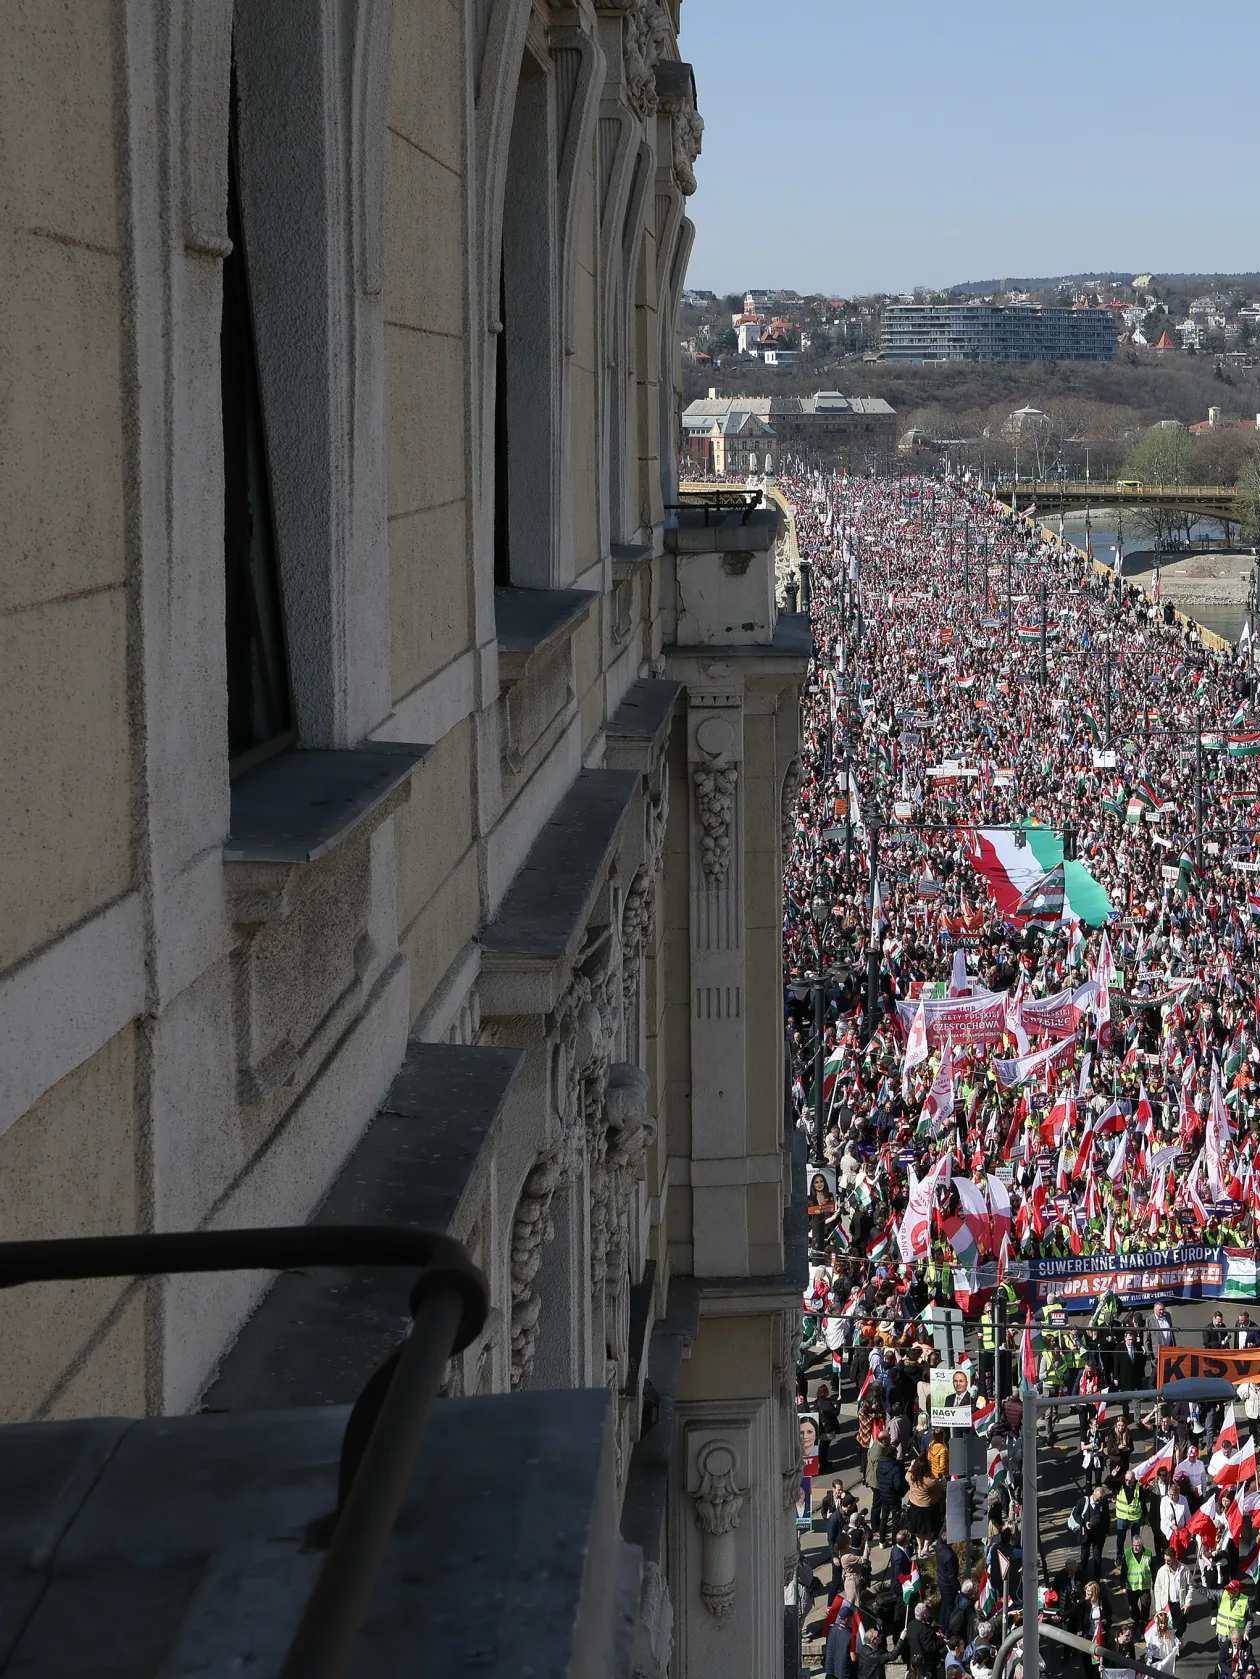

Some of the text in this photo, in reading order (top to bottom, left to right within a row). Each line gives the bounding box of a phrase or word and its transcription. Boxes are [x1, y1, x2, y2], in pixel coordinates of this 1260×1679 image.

[1237, 741, 1258, 749] AJKA
[1137, 971, 1163, 979] TAPOLCA
[901, 1221, 909, 1257] GRANIC
[1039, 1247, 1220, 1276] SUWERENNE NARODY EUROPY
[1039, 1266, 1220, 1296] EURÓPA SZVERÉN NEMZETEI
[932, 1409, 957, 1417] NAGY
